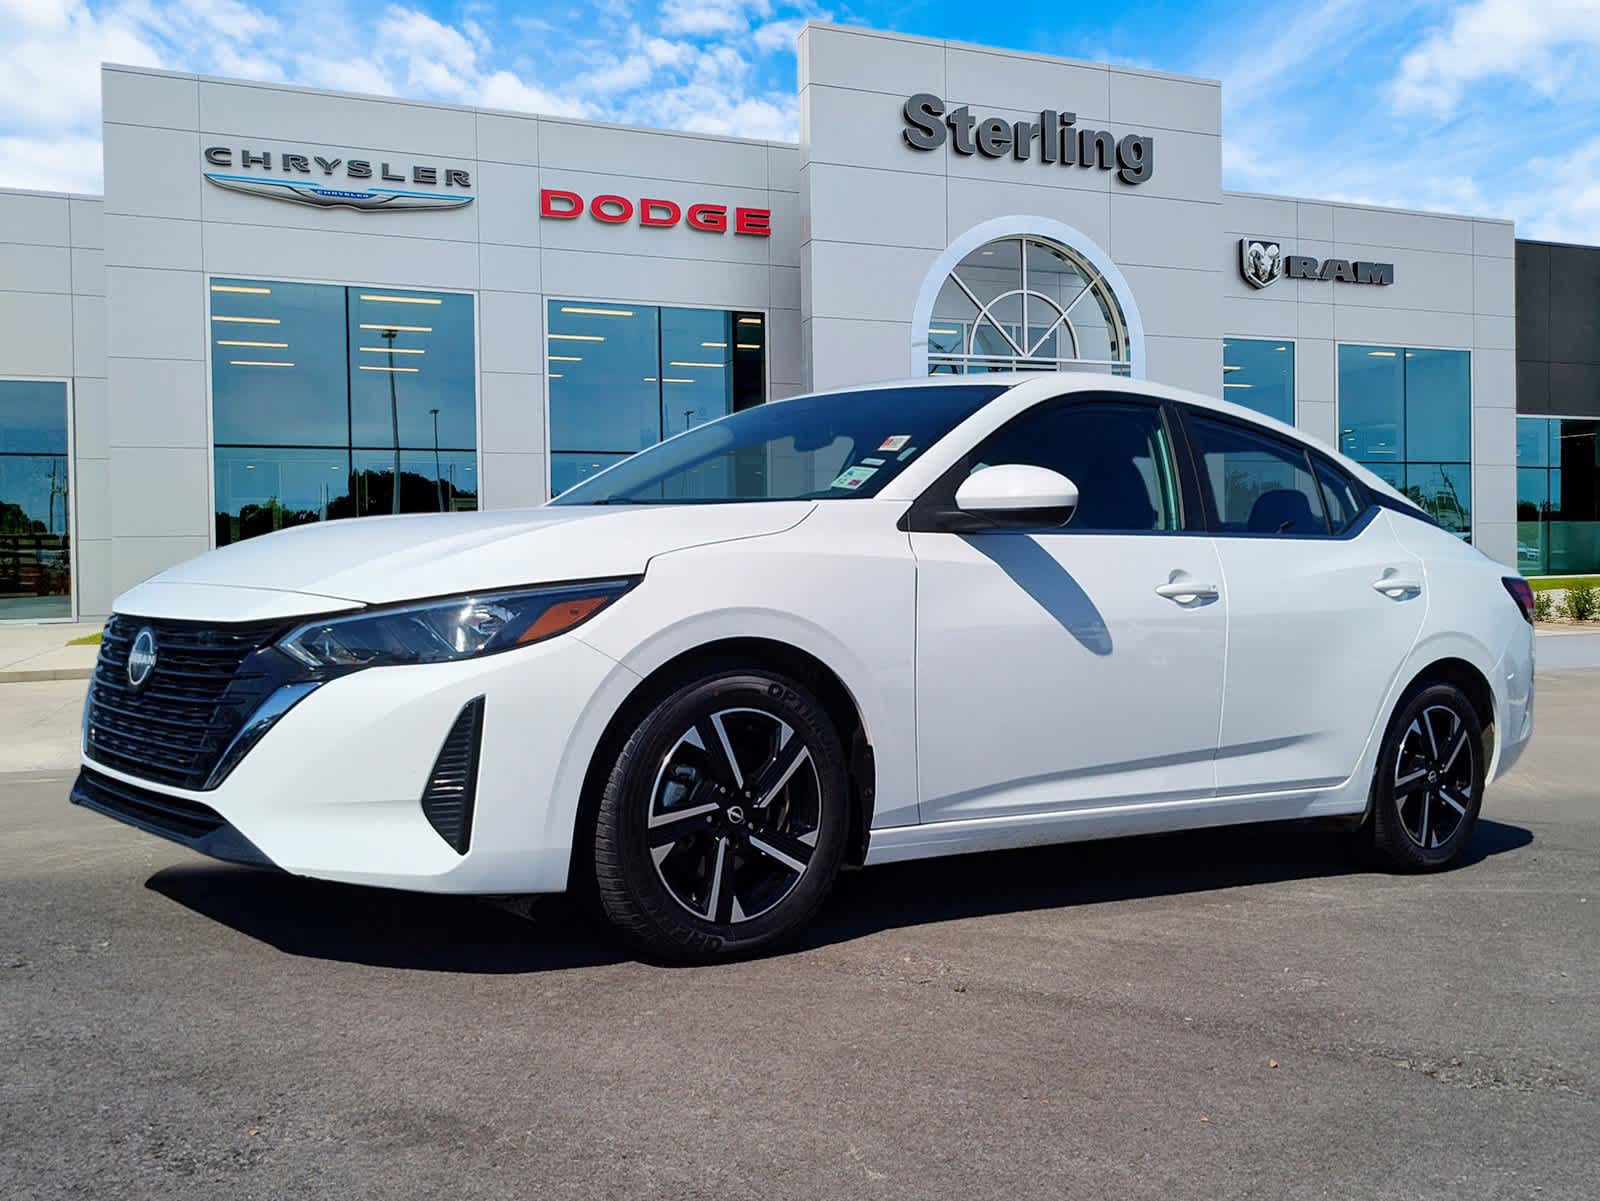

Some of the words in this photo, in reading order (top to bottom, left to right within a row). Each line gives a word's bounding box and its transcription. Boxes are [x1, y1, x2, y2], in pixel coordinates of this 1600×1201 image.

[902, 93, 1154, 185] Sterling
[204, 146, 472, 187] CHRYSLER
[540, 188, 771, 236] DODGE
[1285, 255, 1394, 286] RAM
